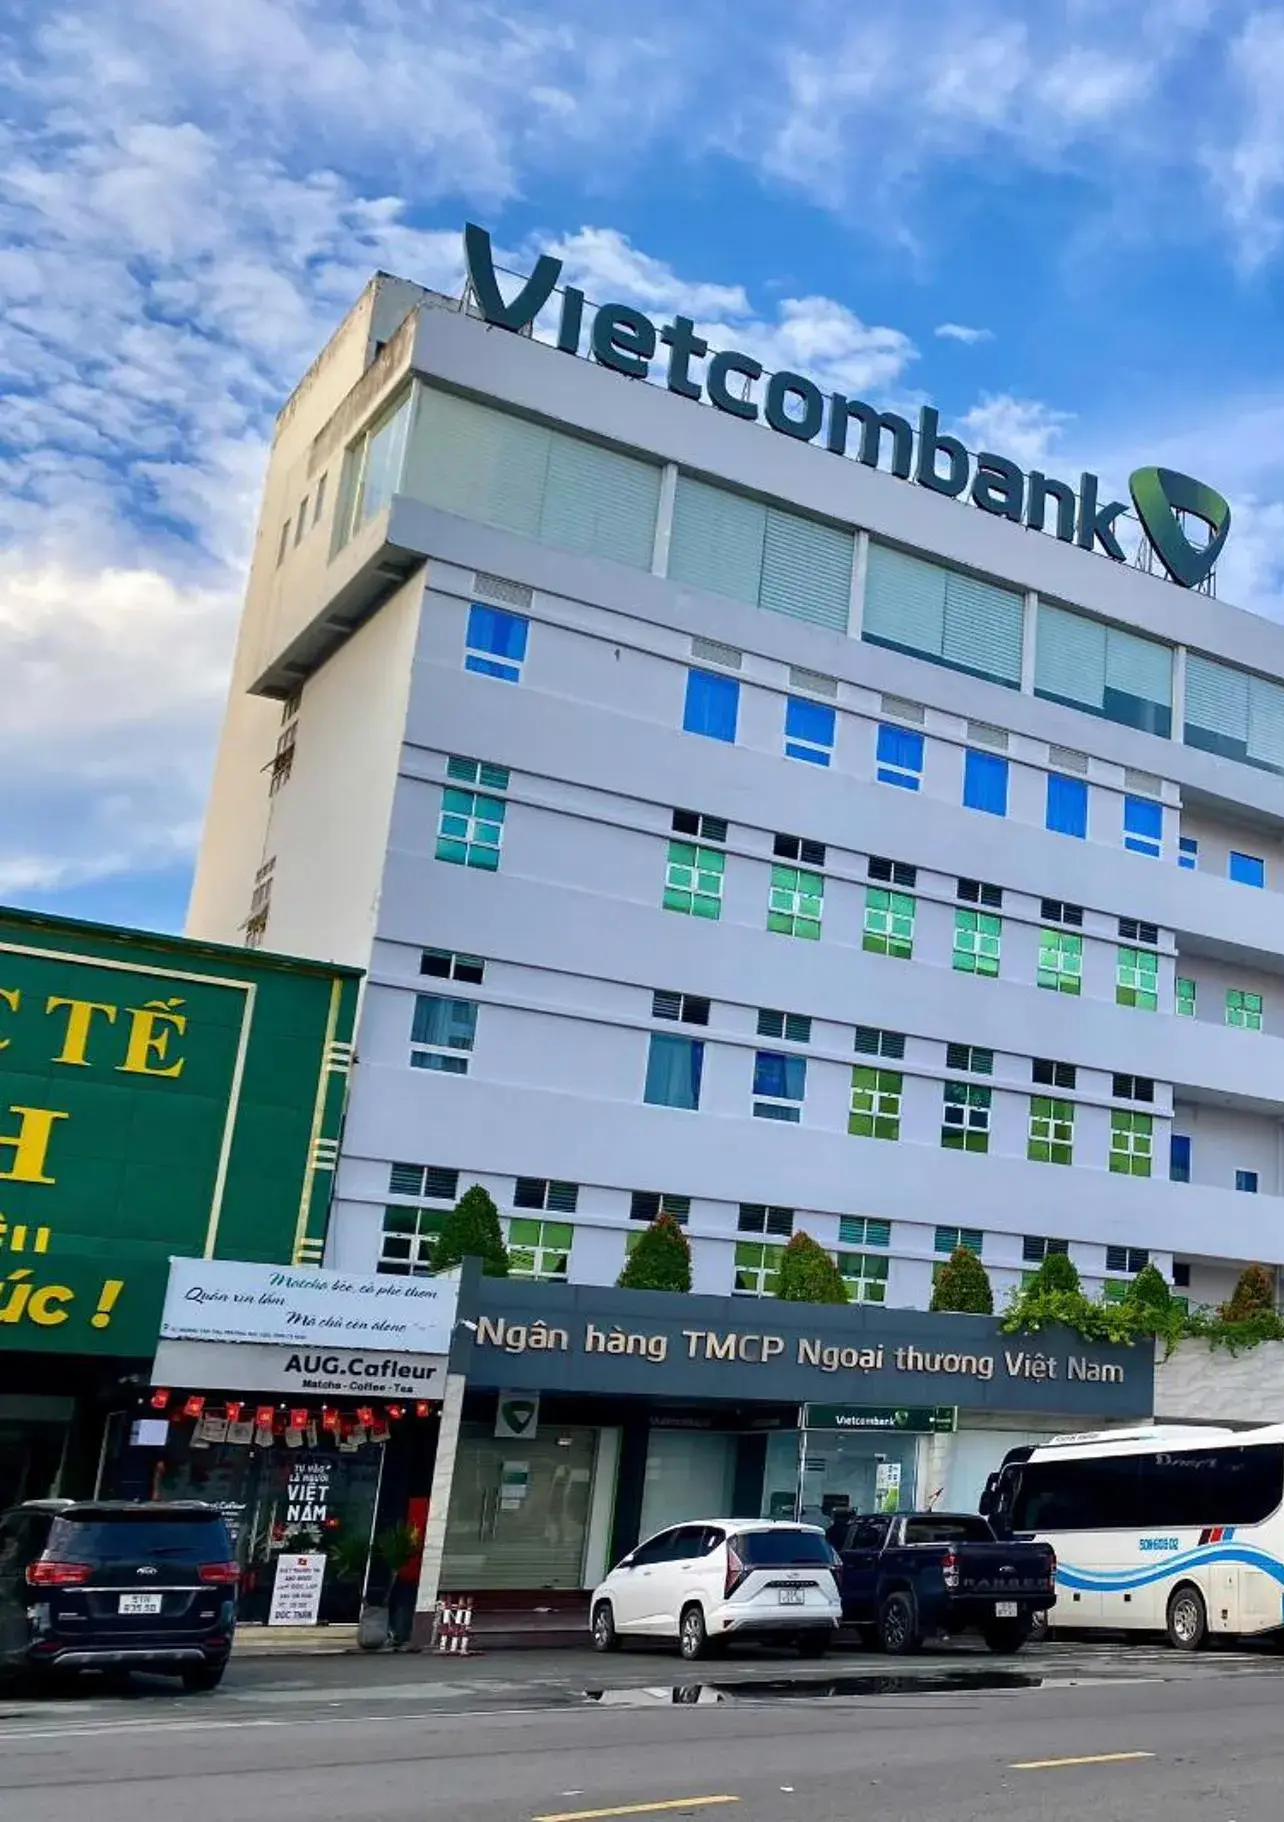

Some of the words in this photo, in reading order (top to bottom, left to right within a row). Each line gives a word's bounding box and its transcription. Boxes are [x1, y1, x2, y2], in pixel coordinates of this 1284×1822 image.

[463, 221, 1130, 562] Vietcombank
[46, 996, 188, 1078] TẾ
[284, 1354, 437, 1379] AUG.Cafleur
[476, 1316, 568, 1354] Ngân
[585, 1323, 668, 1362] hàng
[682, 1330, 785, 1362] TMCP
[797, 1338, 884, 1374] Ngoại
[894, 1345, 994, 1380] thương
[1004, 1351, 1057, 1383] Việt
[1067, 1356, 1124, 1383] Nam
[302, 1379, 341, 1390] Matcha
[350, 1381, 386, 1392] Coffee
[395, 1383, 414, 1393] Tea
[836, 1415, 895, 1426] Vietcombank
